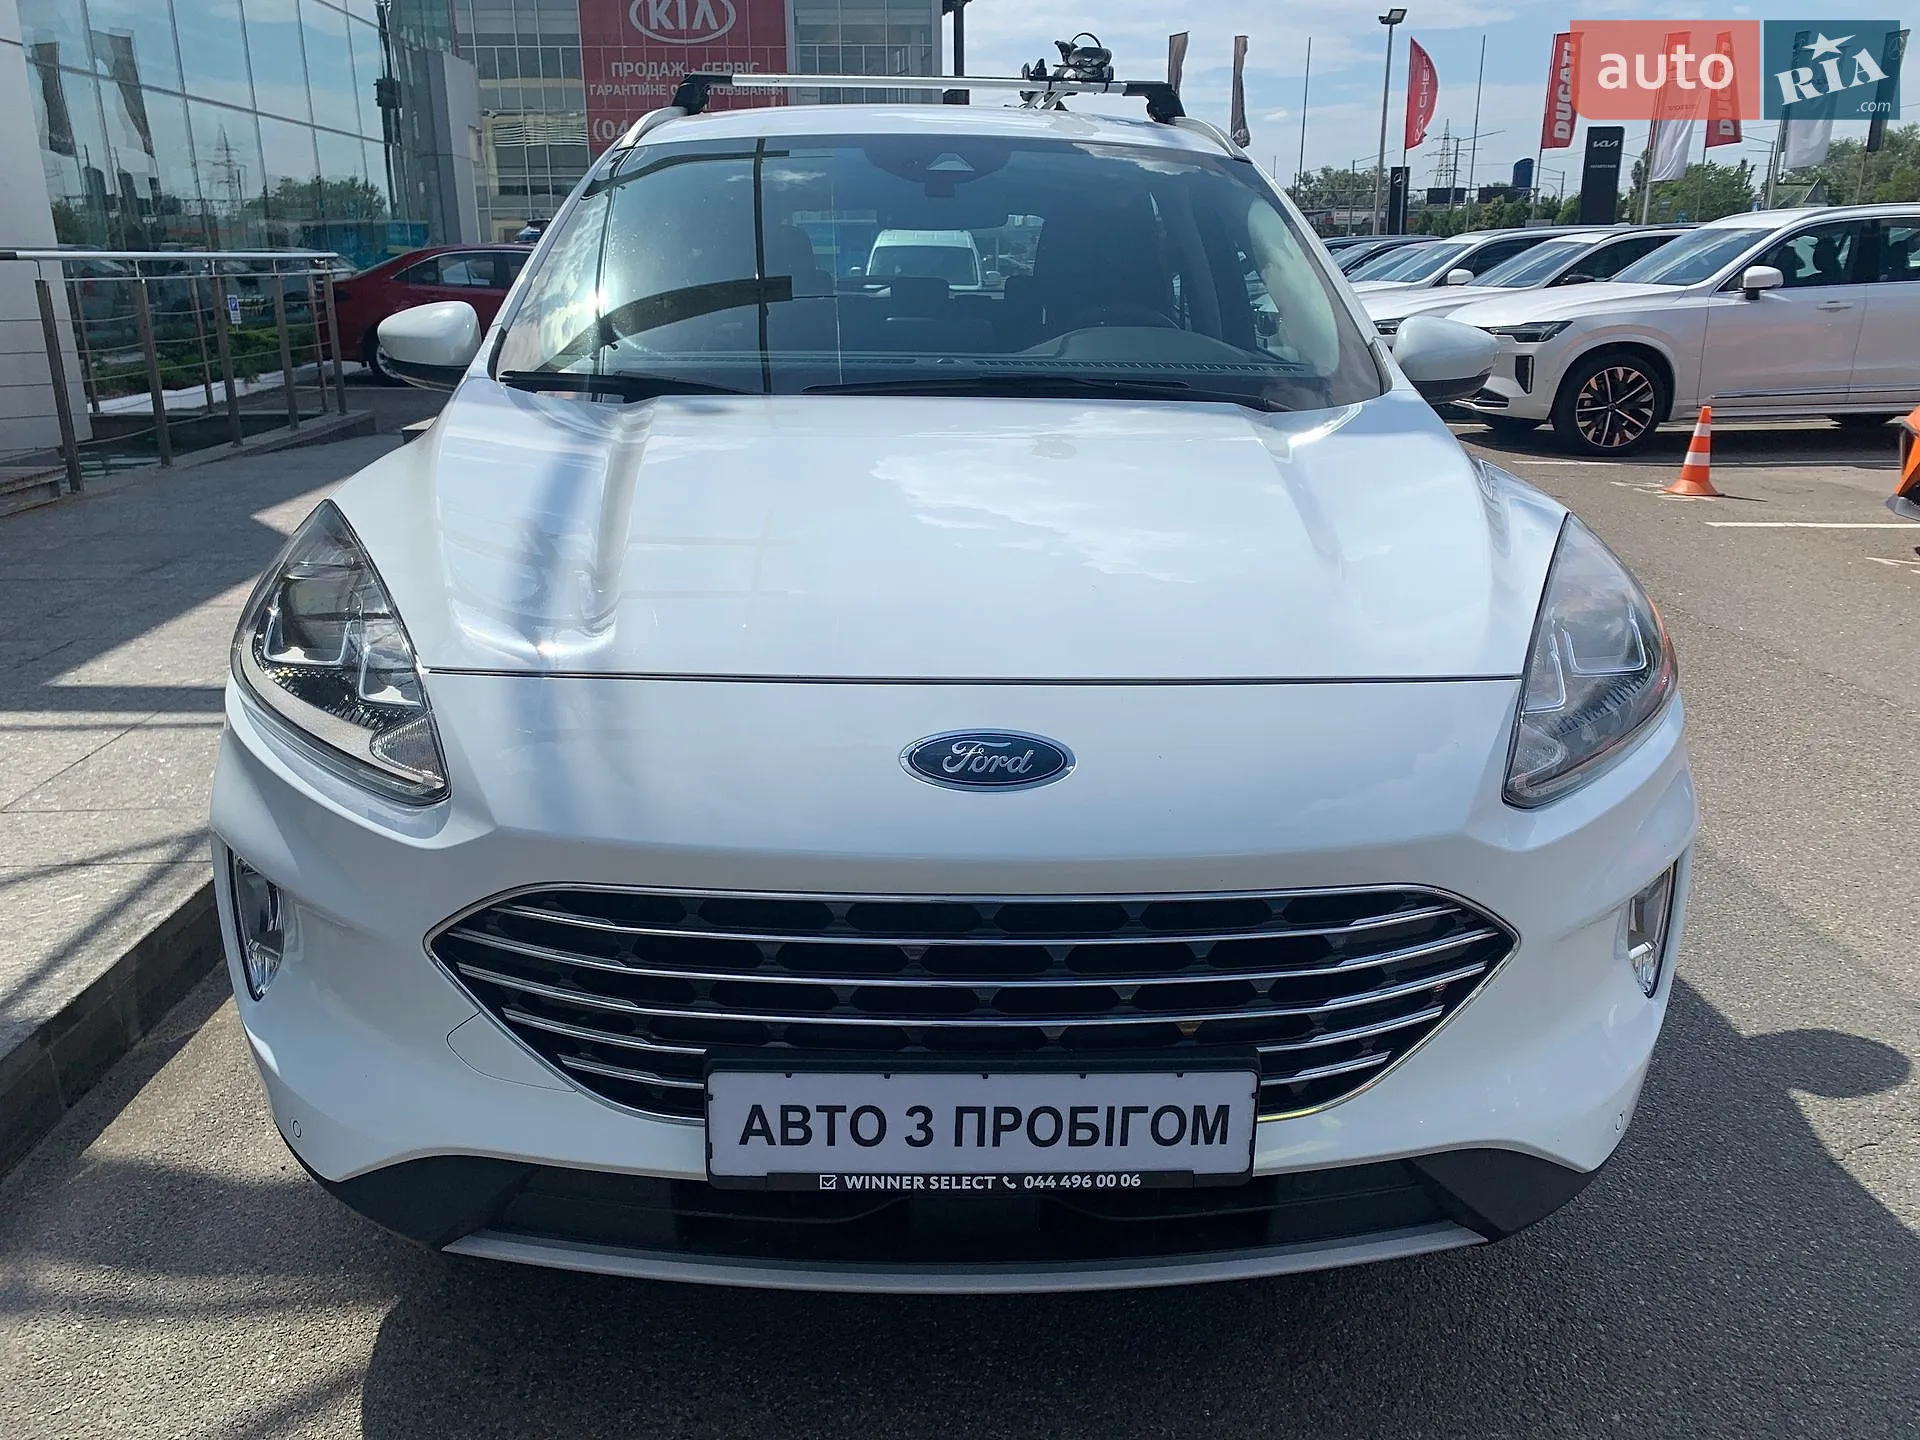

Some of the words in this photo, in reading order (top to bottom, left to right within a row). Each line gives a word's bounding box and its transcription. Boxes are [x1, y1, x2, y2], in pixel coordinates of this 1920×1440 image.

[648, 0, 719, 30] KIA
[611, 62, 685, 80] ПРОДАЖ
[589, 82, 667, 96] ГАРАНТІЙНЕ
[670, 84, 784, 96] ОГОВУВАННЯ
[1553, 41, 1577, 140] DUCATI
[942, 740, 1034, 774] Ford
[738, 1104, 888, 1147] АВТО
[954, 1104, 1230, 1148] ПРОБІГОМ
[845, 1175, 925, 1190] WINNER
[928, 1175, 996, 1190] SELECT
[1024, 1174, 1058, 1189] 044
[1060, 1174, 1093, 1189] 496
[1096, 1174, 1117, 1189] 00
[1119, 1174, 1141, 1189] 06
